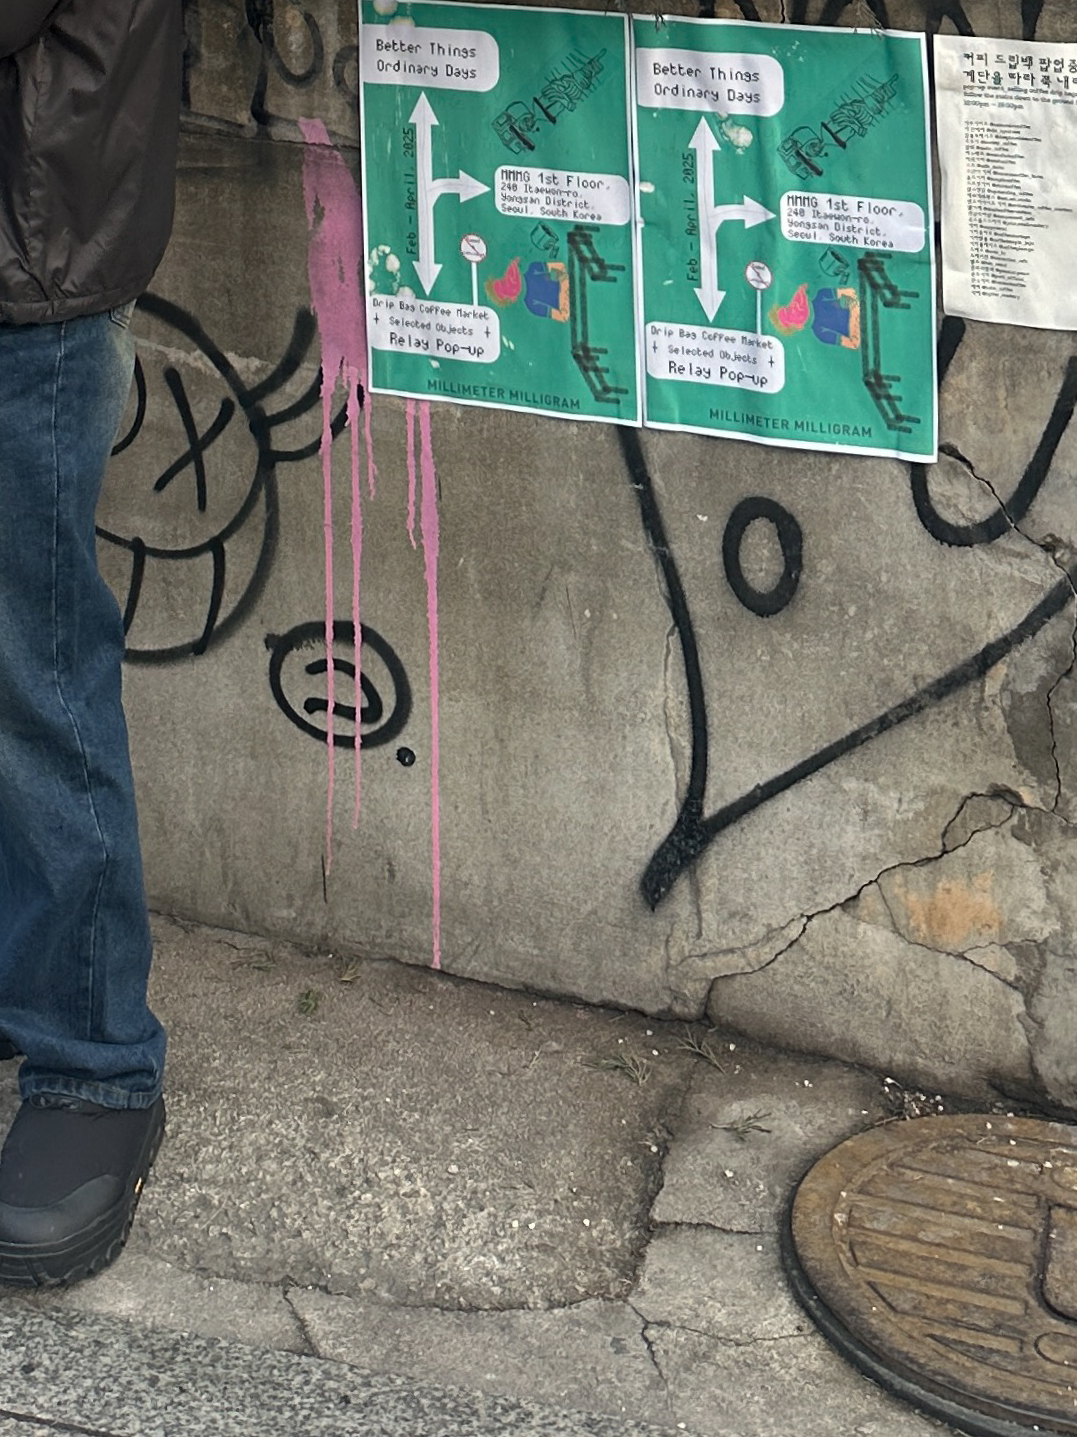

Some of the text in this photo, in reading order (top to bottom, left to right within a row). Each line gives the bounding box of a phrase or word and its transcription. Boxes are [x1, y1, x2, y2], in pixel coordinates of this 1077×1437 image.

[376, 38, 476, 59] Better Things
[377, 59, 477, 79] Ordinary Days
[653, 62, 760, 83] Better Things
[963, 52, 988, 66] 커피
[995, 54, 1033, 70] 드립백
[1039, 57, 1065, 73] 팝업
[1008, 72, 1036, 86] 따라
[654, 83, 761, 104] Ordinary Days
[403, 127, 414, 158] 2025
[501, 169, 530, 183] MMMG
[538, 172, 559, 186] 1st
[682, 152, 694, 184] 2025
[501, 182, 518, 192] 240
[501, 192, 540, 205] Yongsan
[787, 194, 818, 208] MMMG
[826, 198, 848, 212] 1st
[540, 206, 568, 218] South
[573, 211, 602, 222] Korea
[787, 208, 805, 217] 240
[787, 218, 829, 231] Yongsan
[406, 231, 417, 255] Feb
[829, 232, 858, 245] South
[863, 237, 894, 248] Korea
[686, 258, 698, 282] Feb
[373, 297, 489, 321] Drip Bag Coffee Market
[389, 316, 474, 336] Selected Objects
[390, 332, 485, 357] Relay Pop-up
[651, 325, 773, 350] Drip Bag Coffee Market
[668, 344, 758, 366] Selected Objects
[668, 360, 769, 388] Relay Pop-up
[427, 379, 581, 410] MILLIMETER MILLIGRAM
[709, 407, 873, 439] MILLIMETER MILLIGRAM
